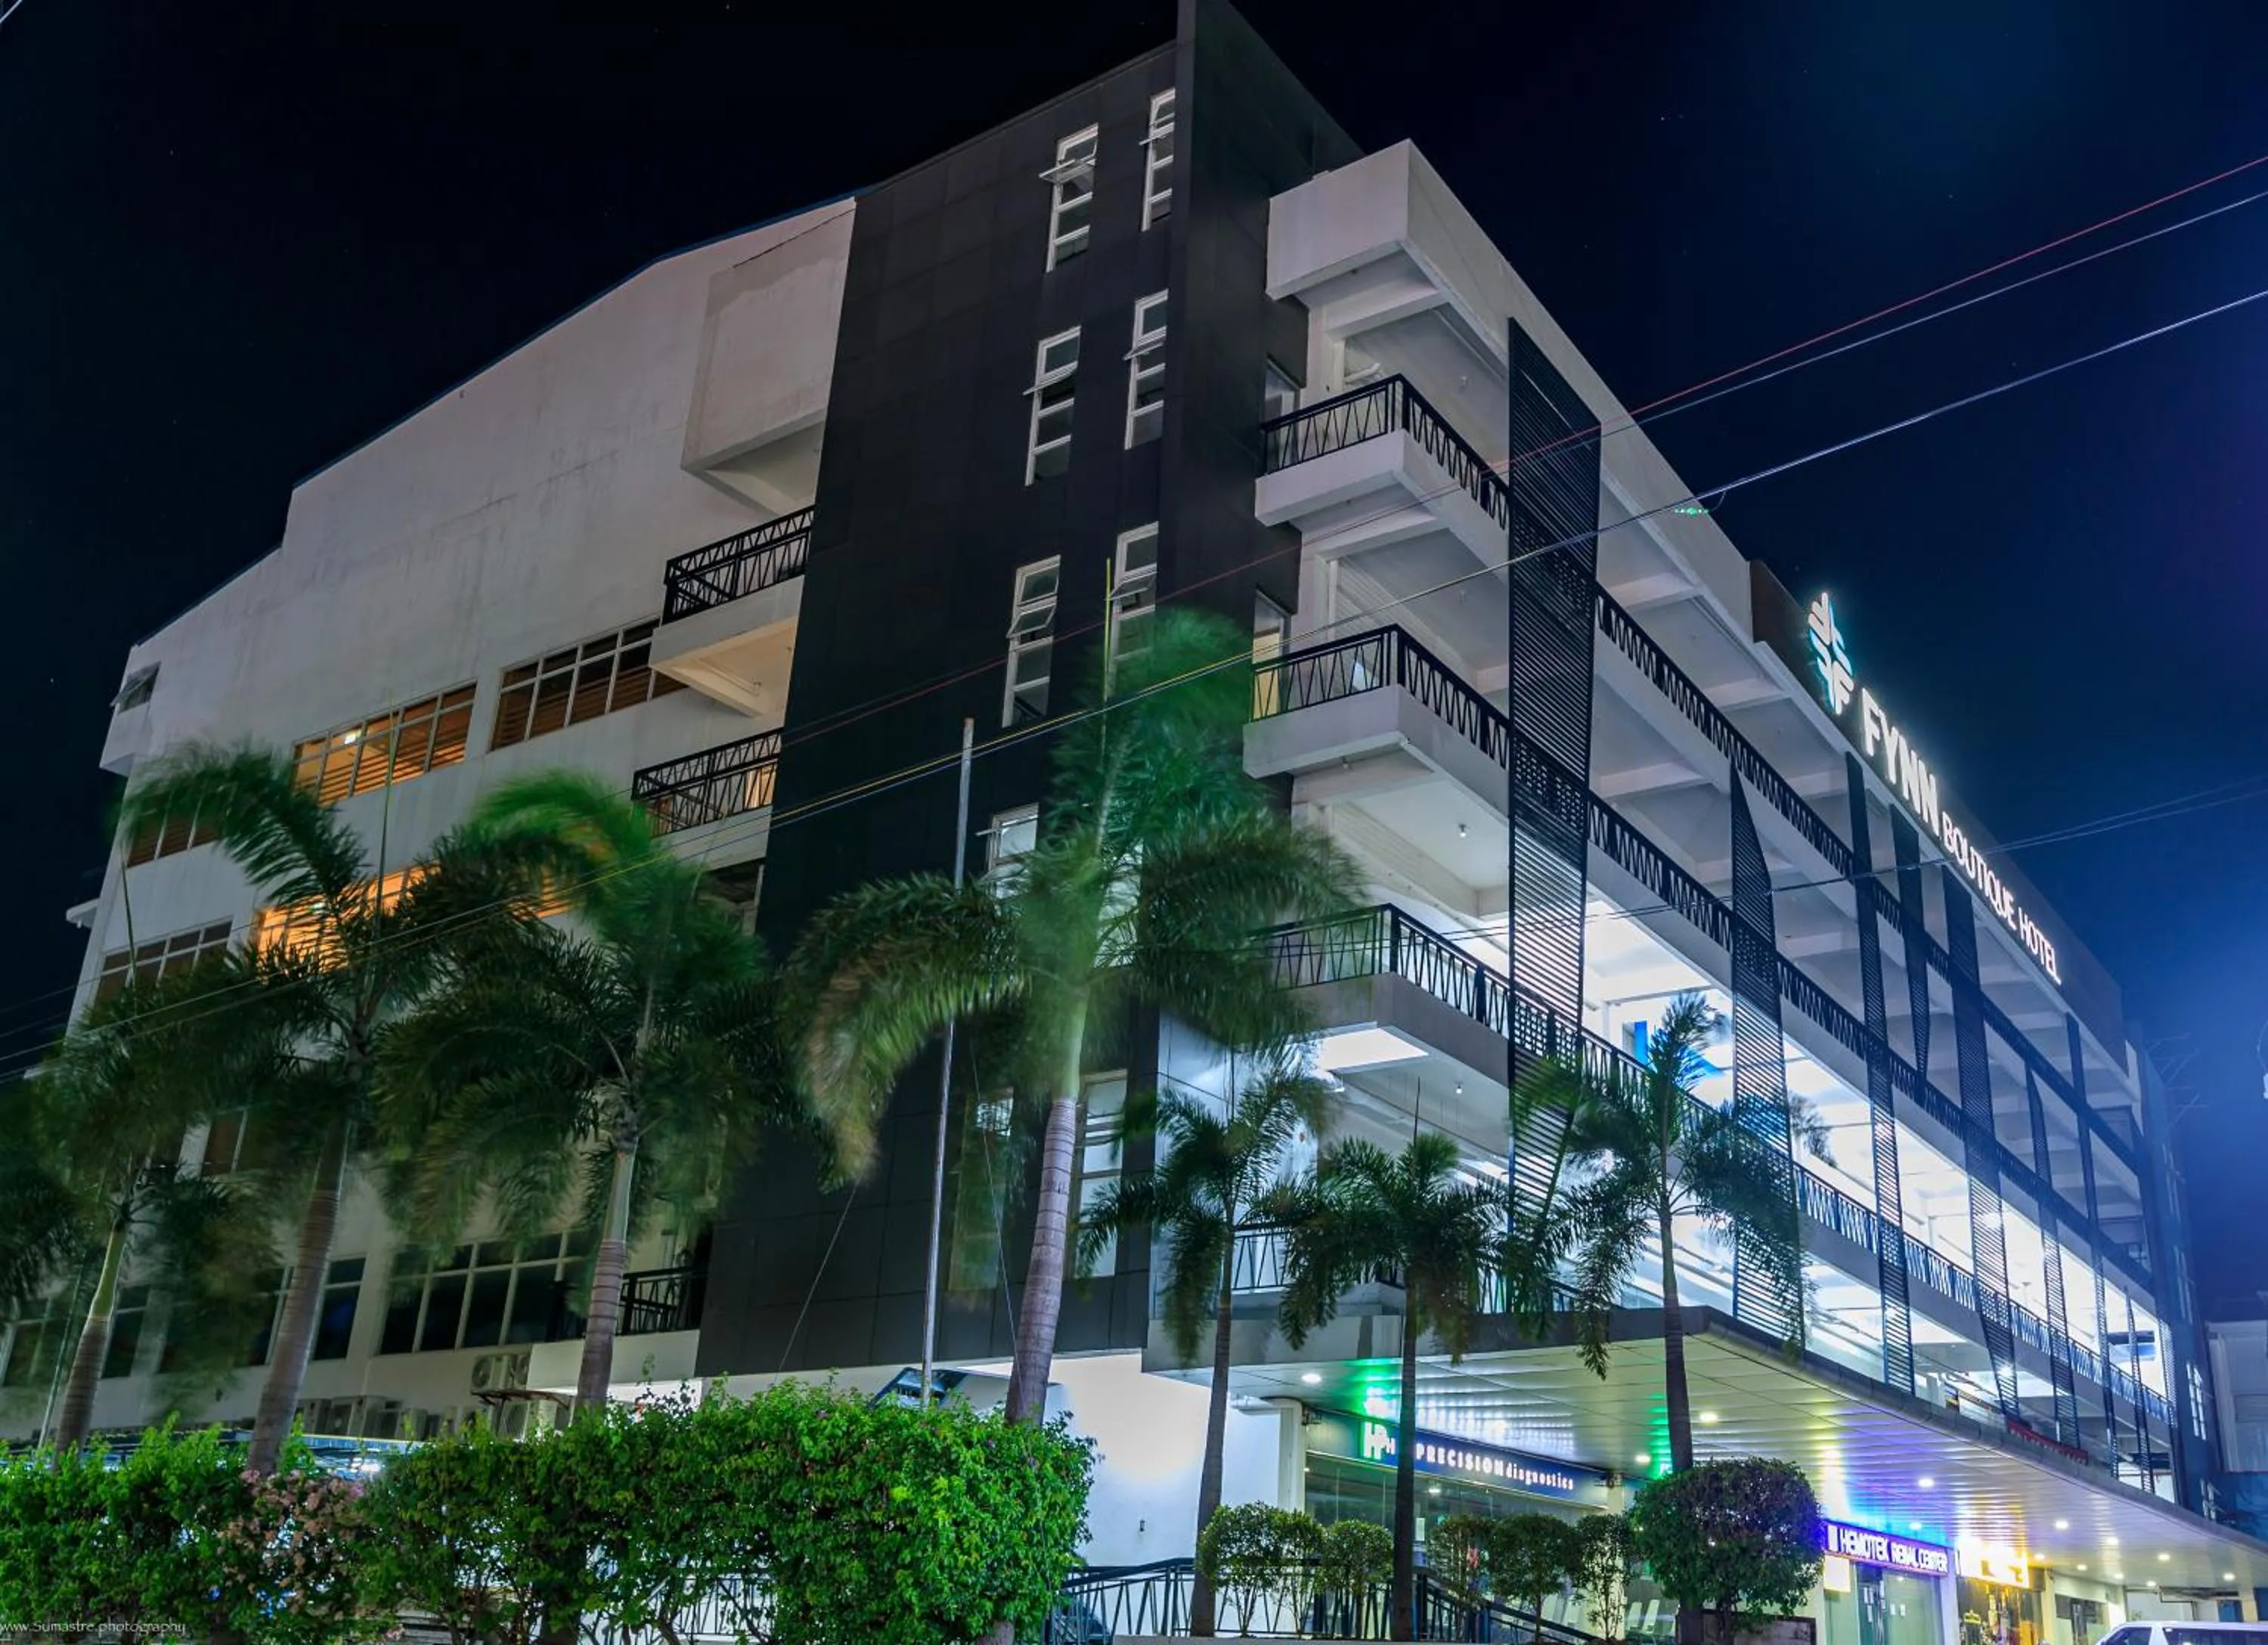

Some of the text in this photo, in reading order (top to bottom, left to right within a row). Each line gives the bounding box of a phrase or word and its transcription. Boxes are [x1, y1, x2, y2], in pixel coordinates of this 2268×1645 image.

[1862, 687, 2062, 986] FYNN BOUTIQUE HOTEL
[1415, 1442, 1504, 1476] PRECISION
[1505, 1462, 1573, 1491] diagnostics
